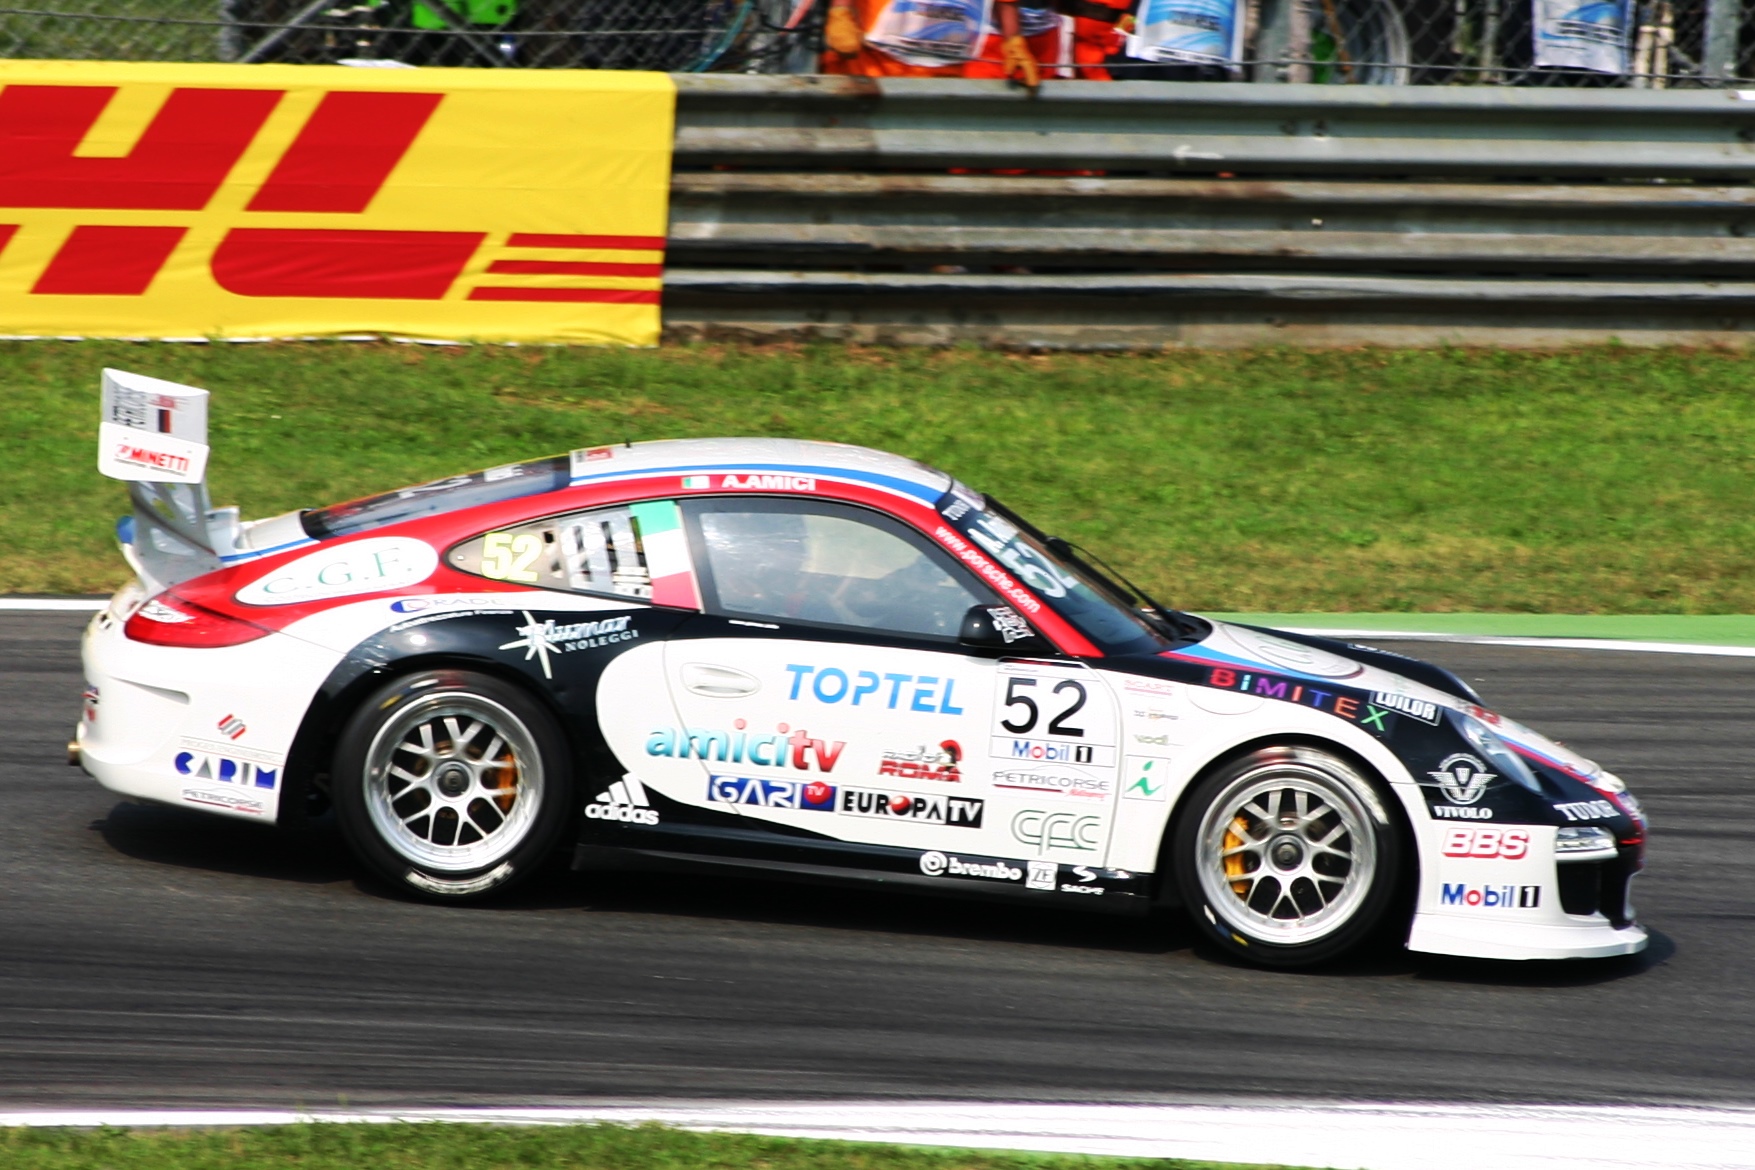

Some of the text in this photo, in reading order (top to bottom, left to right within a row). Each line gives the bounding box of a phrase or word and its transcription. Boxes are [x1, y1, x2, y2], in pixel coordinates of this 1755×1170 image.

[721, 475, 816, 491] A.AMICI
[481, 532, 543, 582] 52
[934, 525, 1042, 614] www.porsche.com
[565, 630, 639, 652] NOLEGGI
[785, 663, 965, 716] TOPTEL
[1000, 676, 1088, 738] 52
[1012, 740, 1070, 762] Mobil
[877, 760, 963, 784] ROMA
[992, 771, 1111, 790] PETRICORSE
[807, 785, 826, 797] TV
[585, 803, 660, 826] adidas
[950, 799, 983, 822] TV
[1433, 806, 1494, 820] VIVOLO
[1441, 827, 1530, 860] BBS
[949, 856, 1023, 882] brembo
[1441, 883, 1515, 908] Mobil
